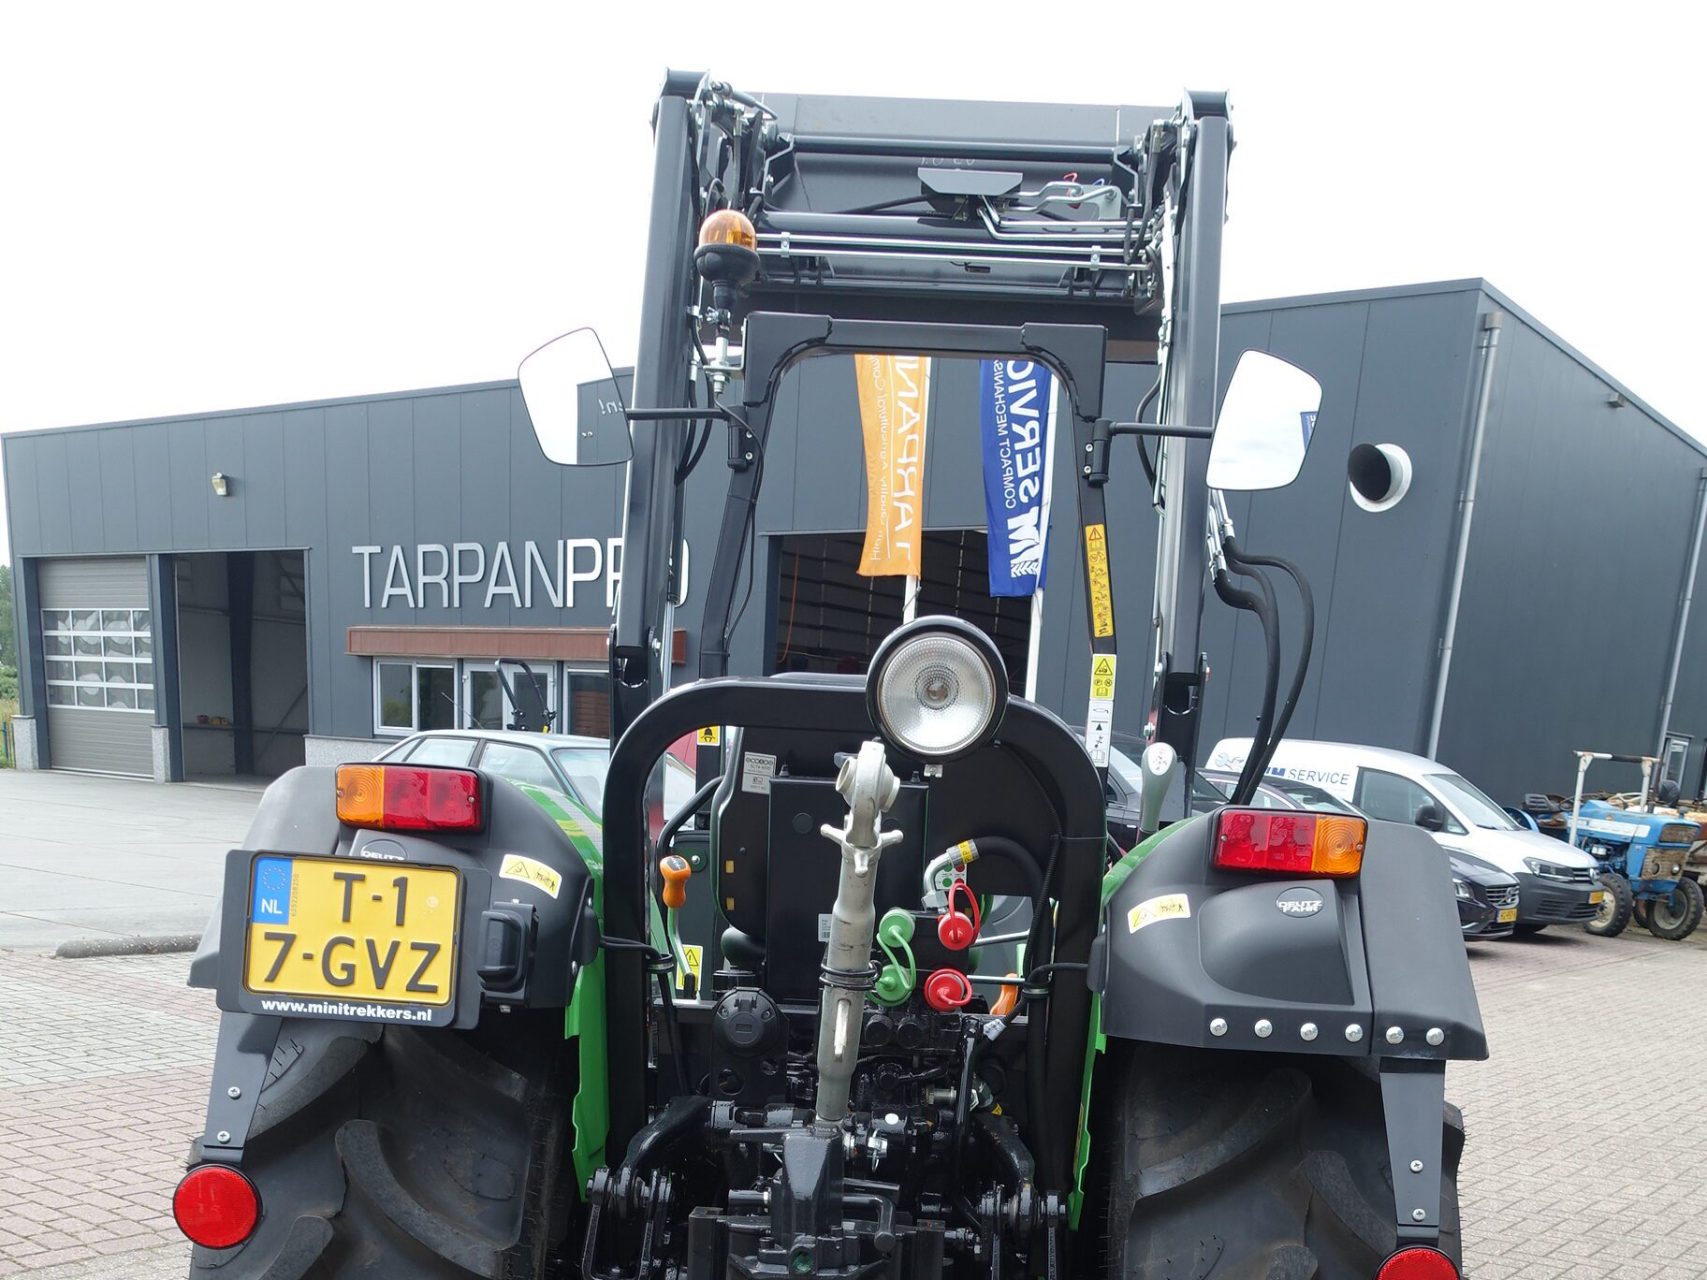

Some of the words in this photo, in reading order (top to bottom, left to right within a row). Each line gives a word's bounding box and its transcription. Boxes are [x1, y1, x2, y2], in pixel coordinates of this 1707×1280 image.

[1288, 768, 1350, 786] SERVICE
[261, 898, 283, 915] NL
[333, 871, 409, 927] T-1
[1278, 900, 1322, 909] DEUTZ
[264, 932, 441, 994] 7-GVZ
[261, 999, 432, 1022] www.minitrekkers.nl
